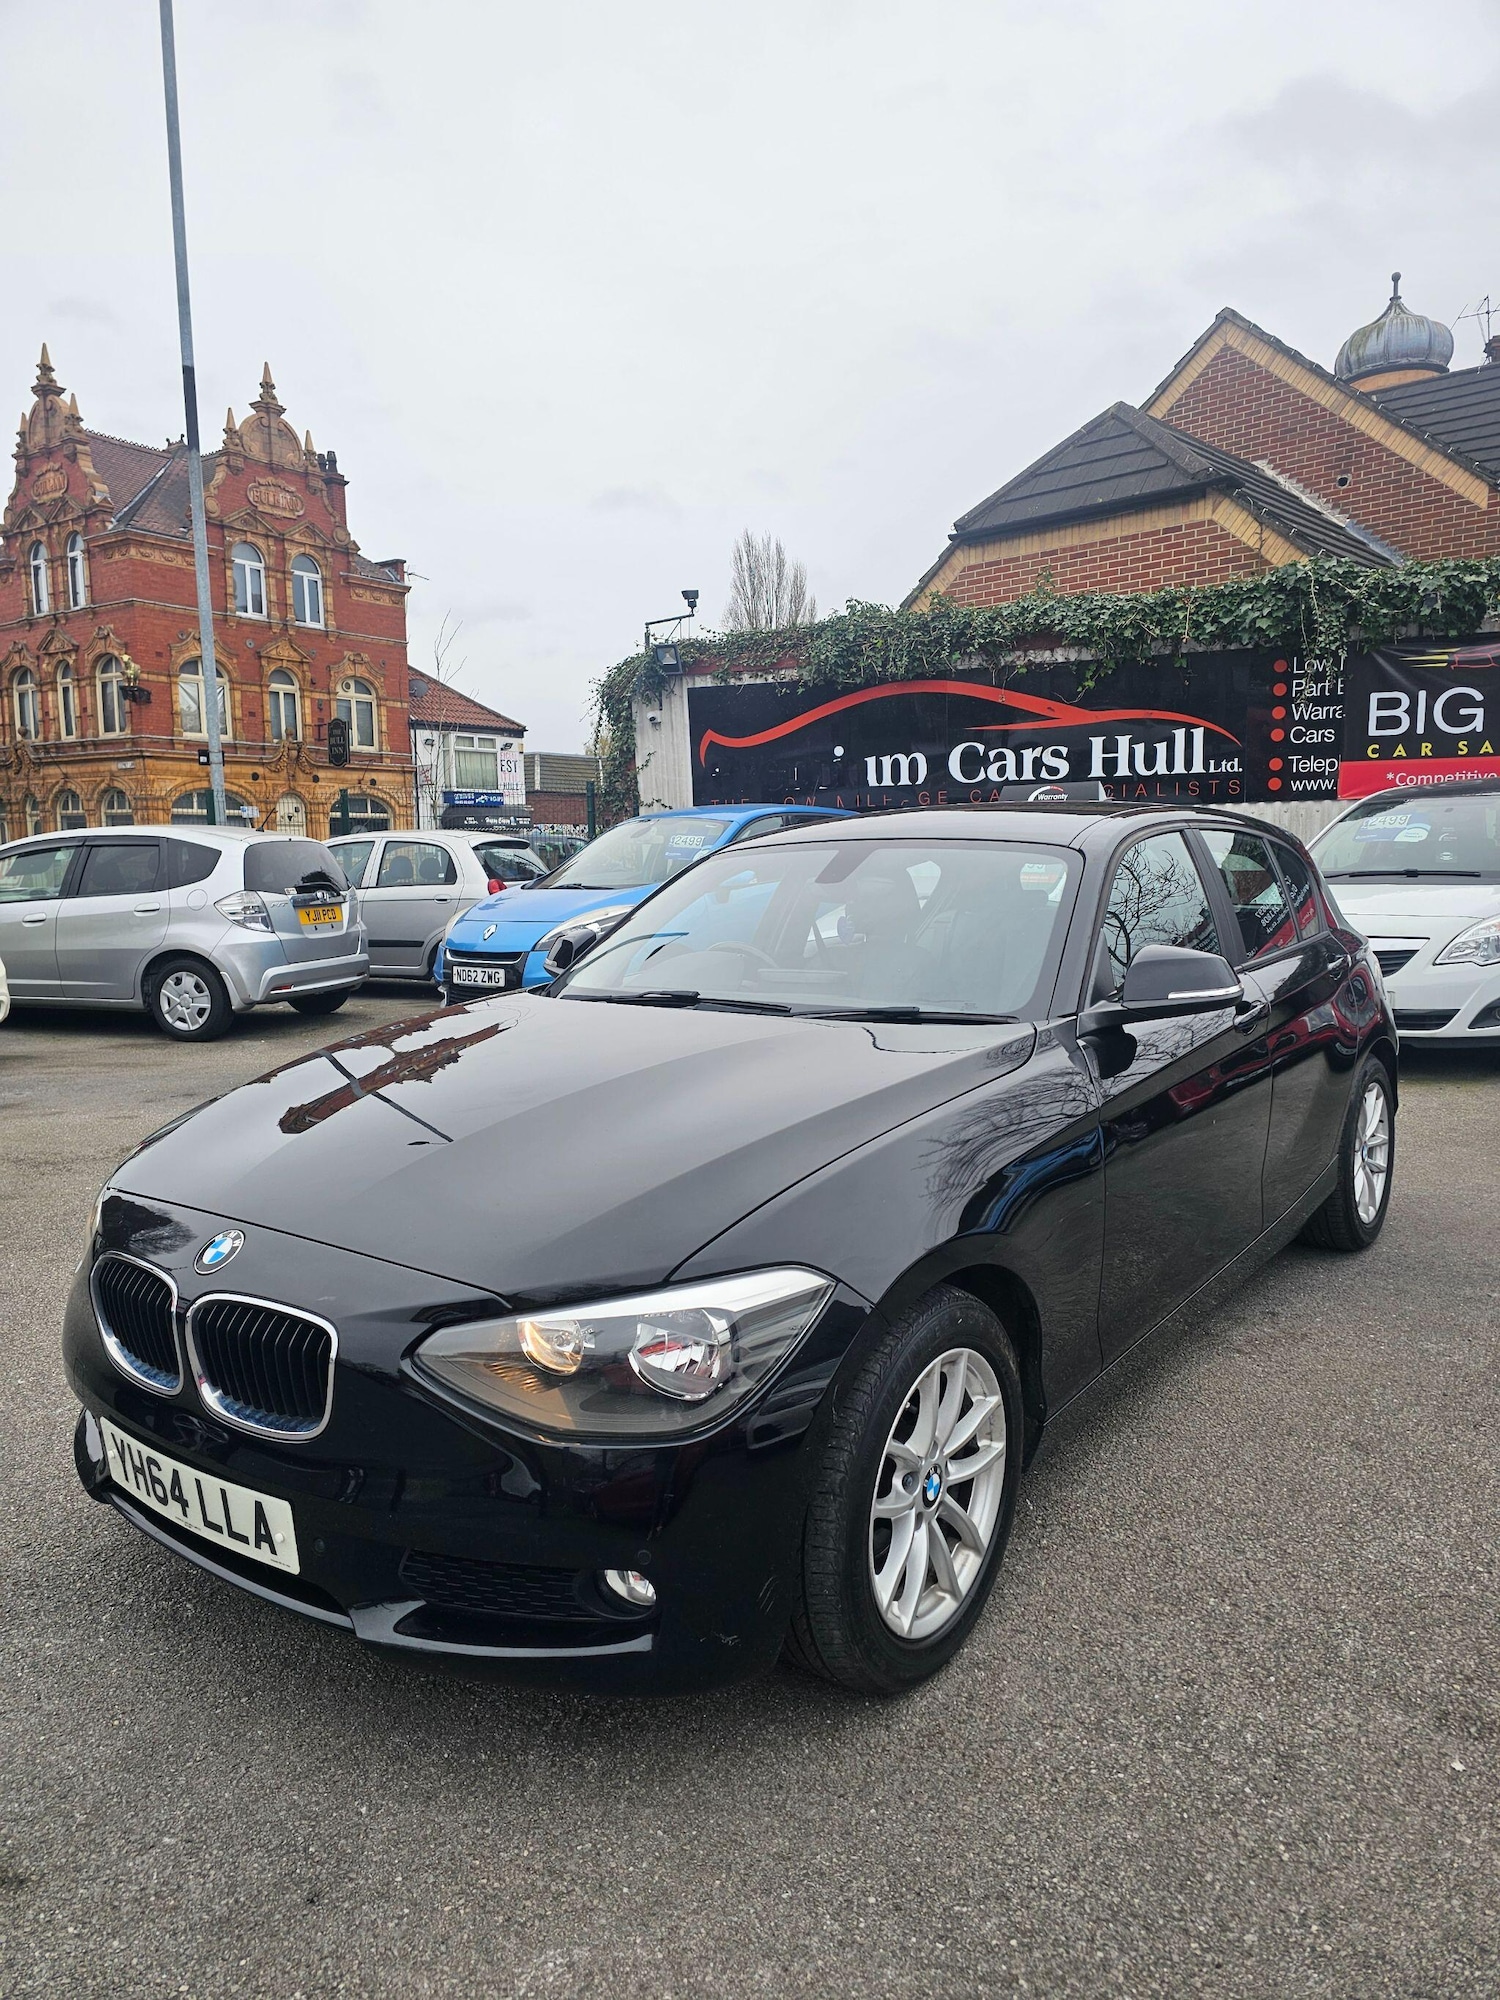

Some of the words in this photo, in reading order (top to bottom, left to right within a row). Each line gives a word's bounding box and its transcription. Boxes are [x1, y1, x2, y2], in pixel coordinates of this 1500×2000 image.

[1292, 679, 1330, 698] Part
[1368, 686, 1485, 736] BIG
[1289, 726, 1336, 744] Cars
[948, 741, 1070, 784] Cars
[1087, 726, 1207, 778] Hull
[1208, 757, 1243, 773] Ltd.
[1366, 742, 1433, 759] CAR
[1457, 740, 1494, 755] SA
[1288, 754, 1342, 776] Telep
[1103, 779, 1241, 800] CIALISTS
[1290, 779, 1337, 792] www.
[1037, 793, 1068, 801] Warranty
[456, 968, 479, 983] ND62
[480, 970, 500, 984] ZWG
[110, 1431, 190, 1519] YH64
[194, 1477, 278, 1557] LLA
